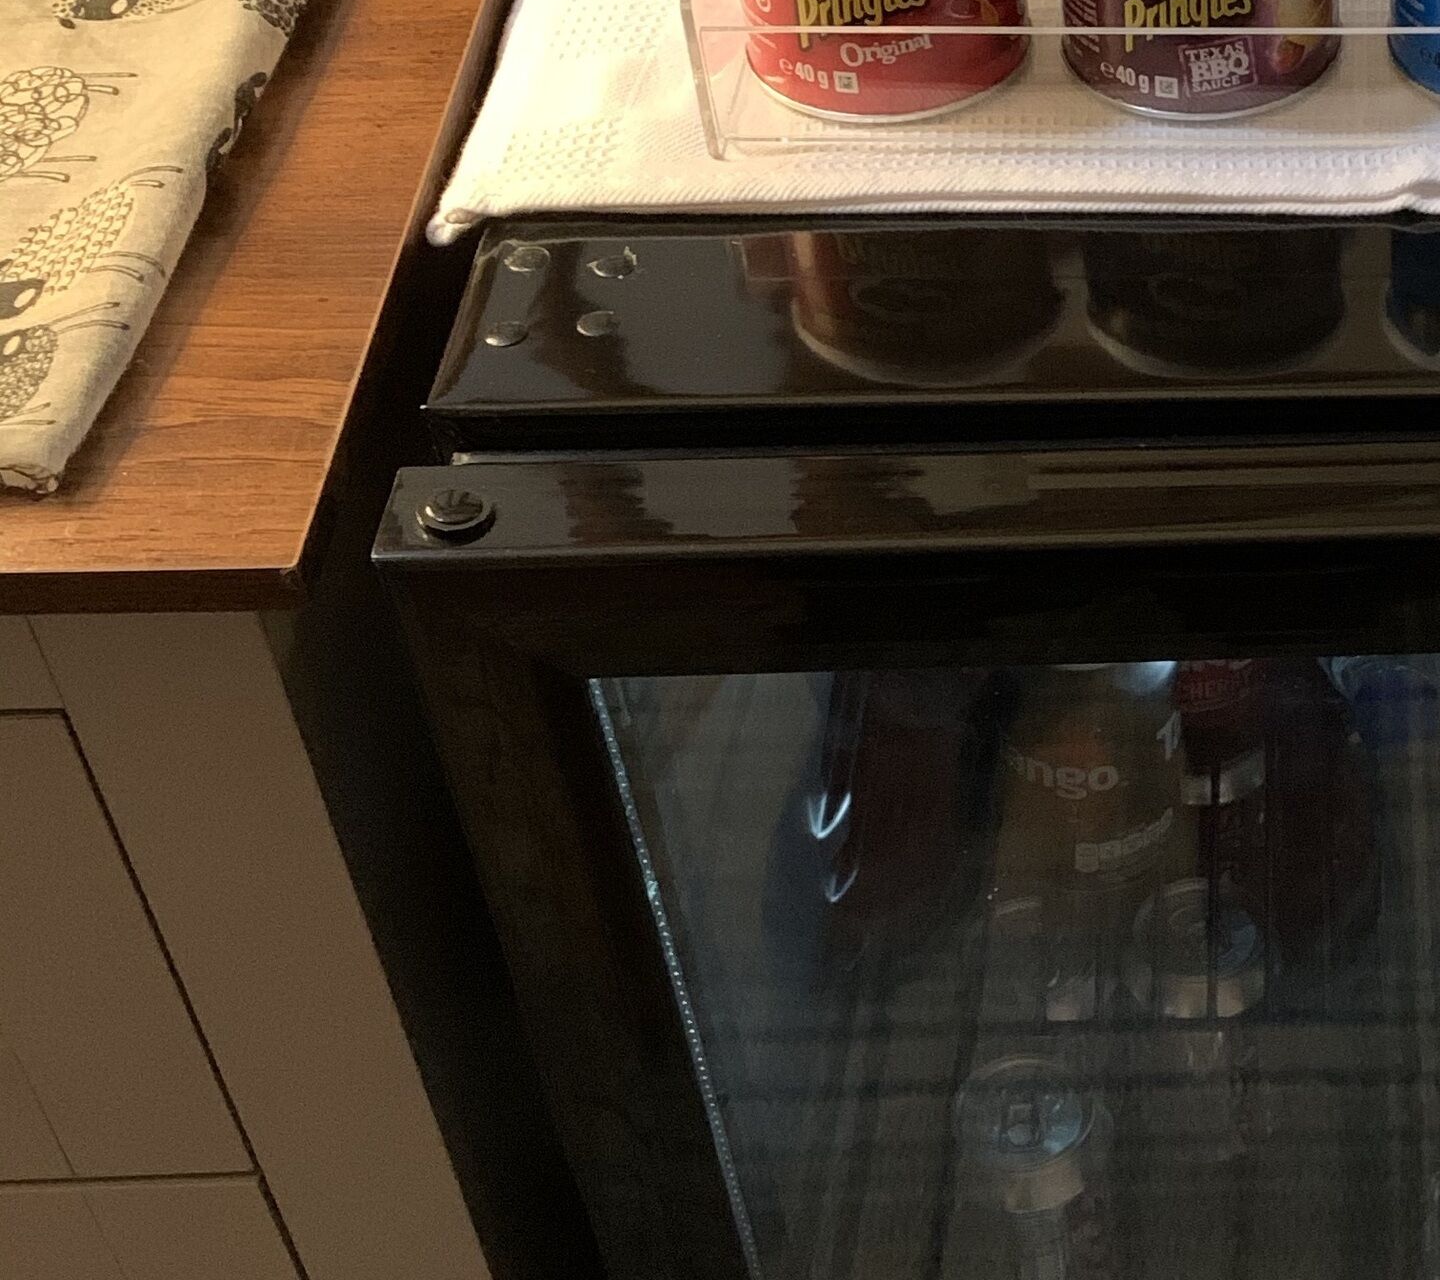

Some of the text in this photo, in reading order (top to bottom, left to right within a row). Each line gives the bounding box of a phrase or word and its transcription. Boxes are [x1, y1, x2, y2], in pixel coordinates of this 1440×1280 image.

[840, 32, 934, 67] Original
[1185, 41, 1245, 63] TEXAS
[1189, 55, 1250, 82] BBQ
[1192, 75, 1242, 94] SAUCE
